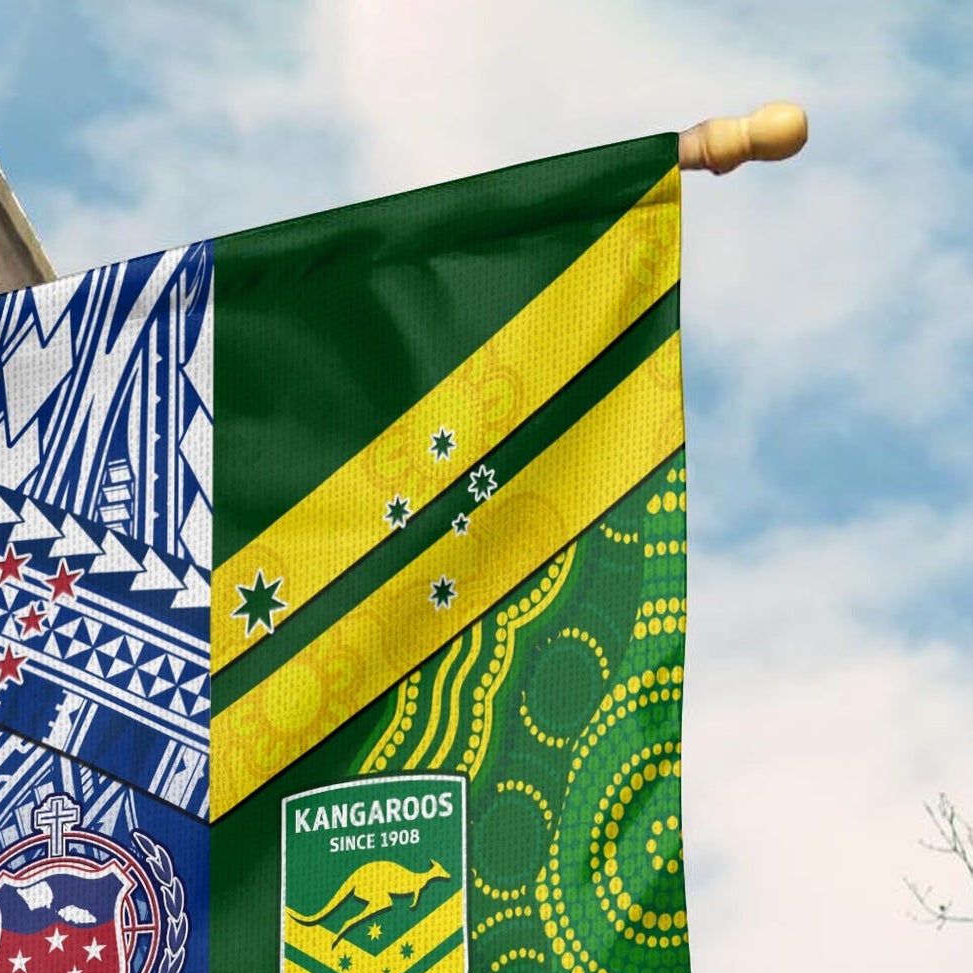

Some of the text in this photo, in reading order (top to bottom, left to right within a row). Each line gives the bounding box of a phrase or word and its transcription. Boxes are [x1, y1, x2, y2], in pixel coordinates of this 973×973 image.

[294, 792, 454, 834] KANGAROOS
[329, 829, 420, 852] SINCE 1908
